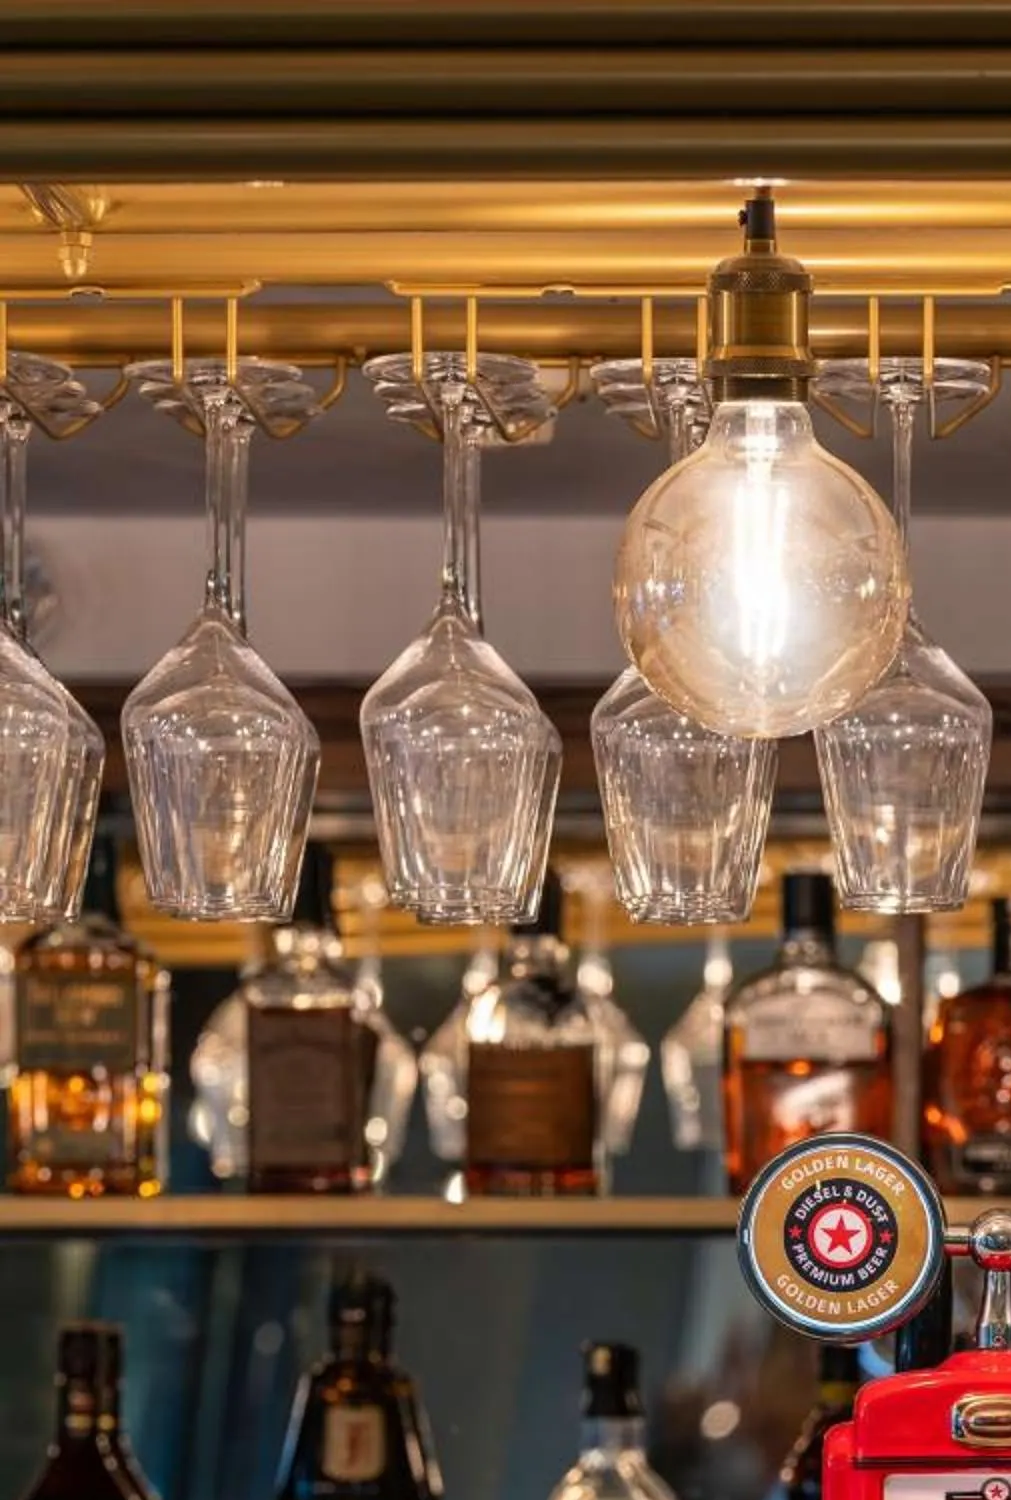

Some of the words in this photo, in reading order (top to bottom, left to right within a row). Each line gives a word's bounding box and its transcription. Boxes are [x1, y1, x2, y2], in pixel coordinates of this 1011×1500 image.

[781, 1155, 849, 1190] GOLDEN
[855, 1157, 905, 1196] LAGER
[795, 1186, 840, 1221] DIESEL
[856, 1190, 889, 1223] DUST
[791, 1243, 855, 1286] PREMIUM
[859, 1247, 888, 1280] BEER
[777, 1274, 841, 1315] GOLDEN
[848, 1279, 899, 1313] LAGER
